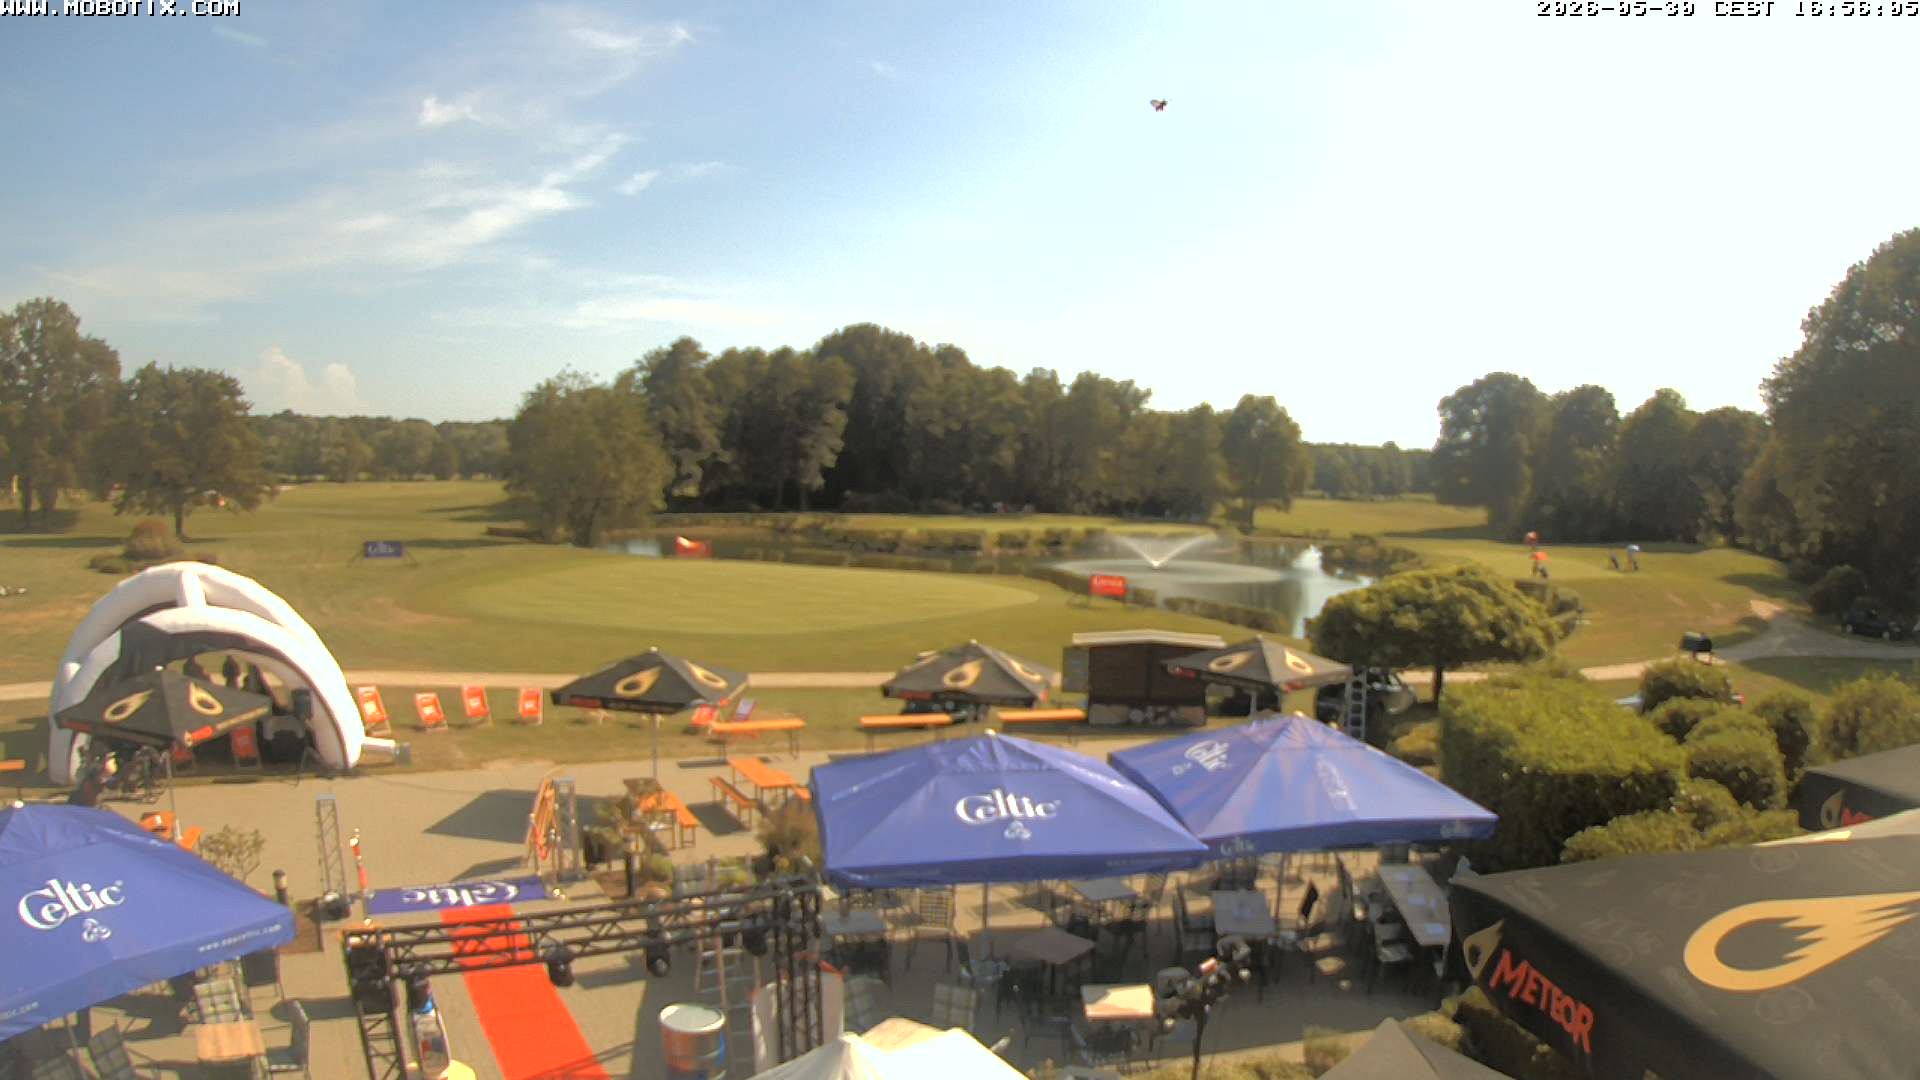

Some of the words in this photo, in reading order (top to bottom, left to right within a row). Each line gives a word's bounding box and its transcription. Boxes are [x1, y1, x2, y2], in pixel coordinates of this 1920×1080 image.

[955, 788, 1057, 825] Celtic
[18, 879, 125, 930] Celtic
[401, 880, 518, 906] Celtic
[1489, 949, 1594, 1053] METEOR
